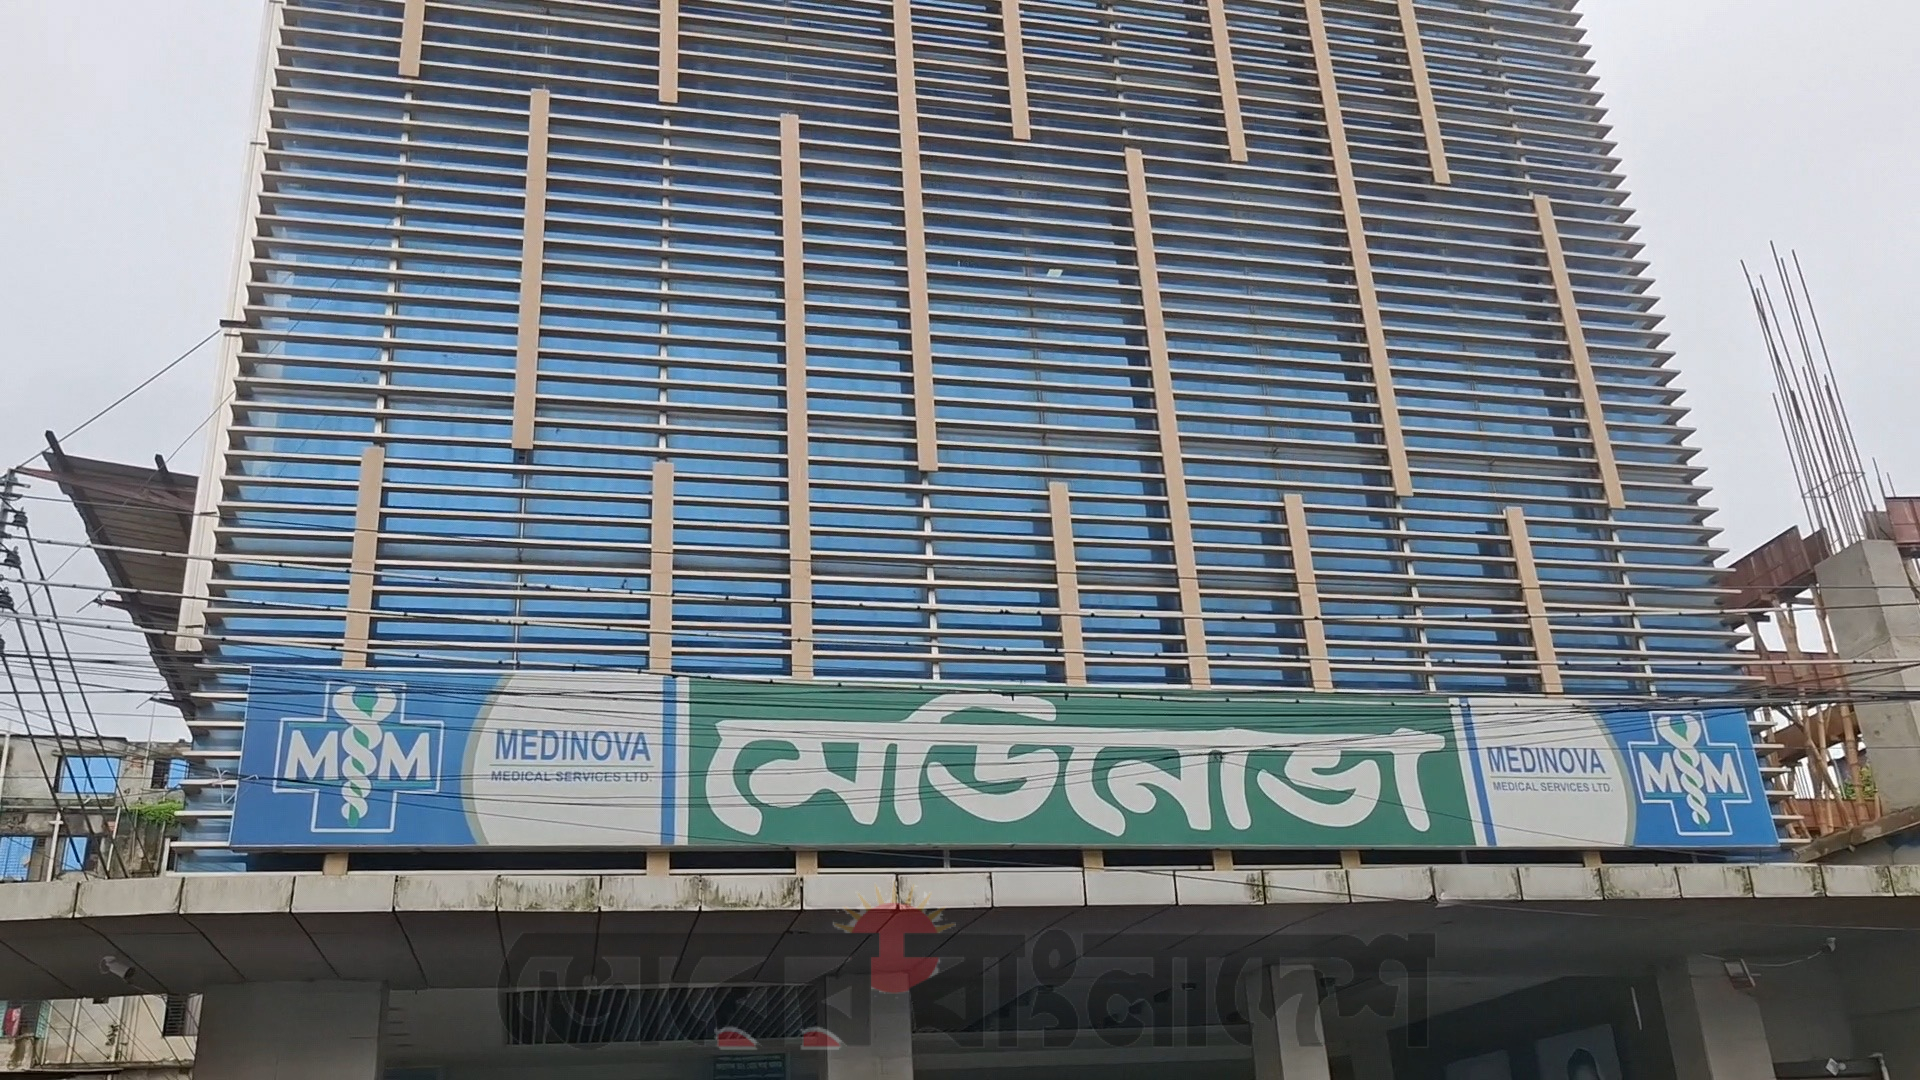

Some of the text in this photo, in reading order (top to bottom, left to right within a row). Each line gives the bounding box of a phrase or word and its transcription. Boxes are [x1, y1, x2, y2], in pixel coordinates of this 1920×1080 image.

[495, 728, 651, 761] MEDINOVA
[705, 693, 1446, 837] মেডিনোভা
[1486, 746, 1607, 774] MEDINOVA
[491, 770, 652, 782] MEDICAL SERVICES LTD.
[1492, 781, 1614, 793] MEDICAL SERVICES LTD.
